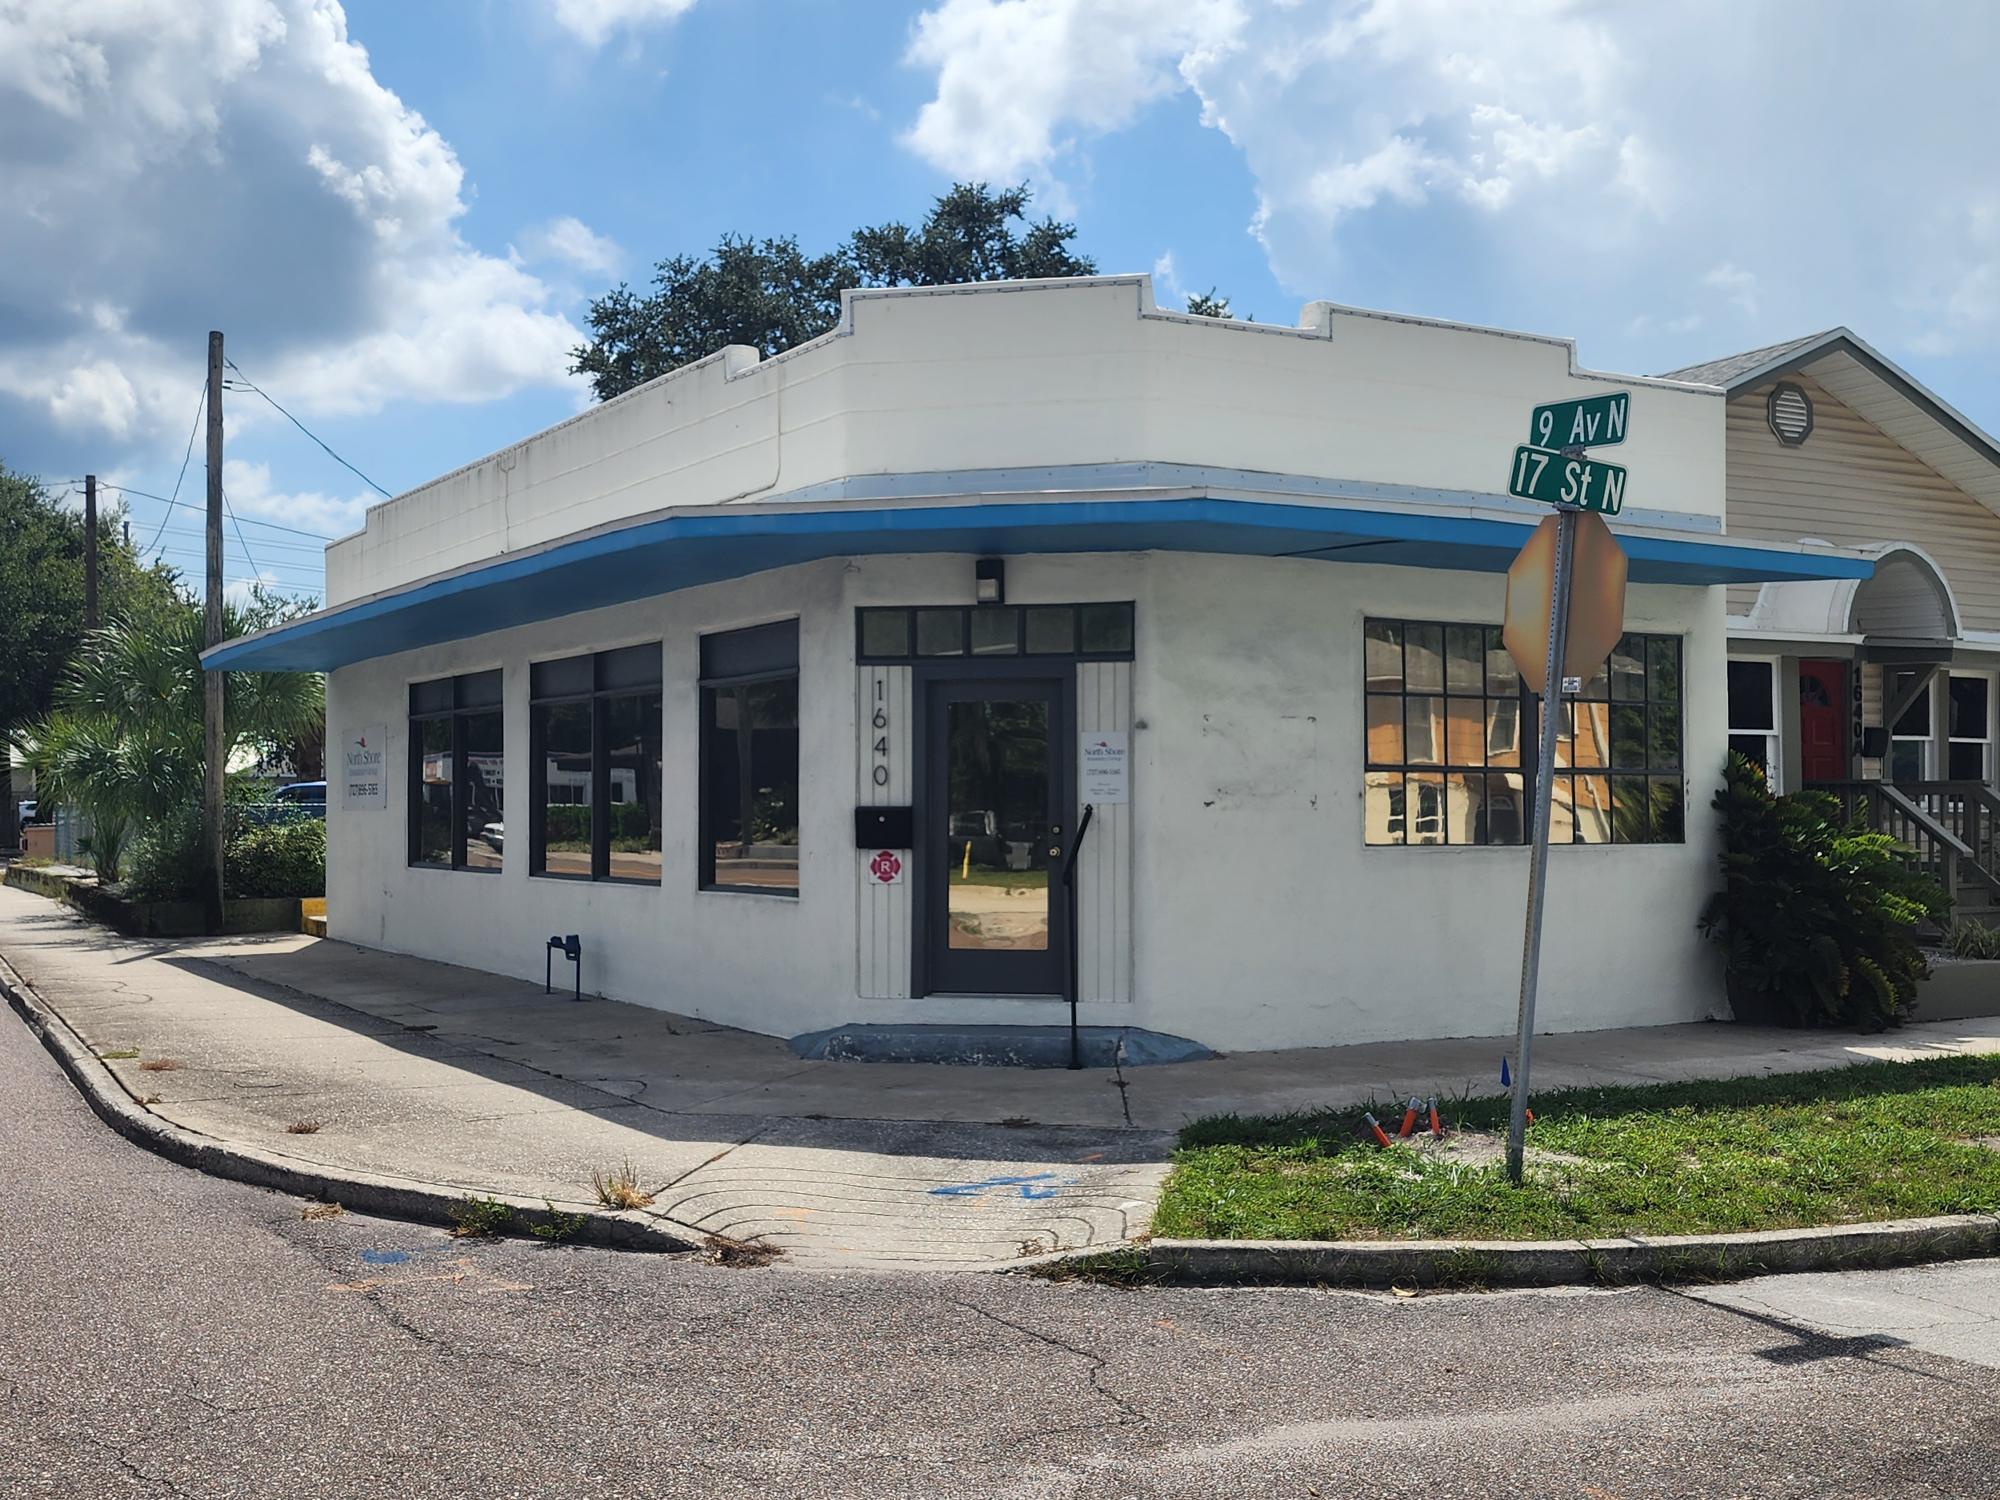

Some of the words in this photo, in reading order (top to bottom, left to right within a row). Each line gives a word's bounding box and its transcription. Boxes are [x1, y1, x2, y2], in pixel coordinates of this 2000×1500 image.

[1539, 410, 1553, 447] 9
[1568, 405, 1601, 444] Av
[1607, 398, 1625, 439] N
[1516, 451, 1549, 495] 17
[1560, 461, 1592, 506] St
[1601, 469, 1624, 512] N
[872, 679, 888, 786] 1640
[346, 751, 363, 766] North
[363, 750, 381, 765] Shore
[1084, 747, 1103, 756] North
[1105, 747, 1125, 756] Shore
[880, 861, 891, 872] R
